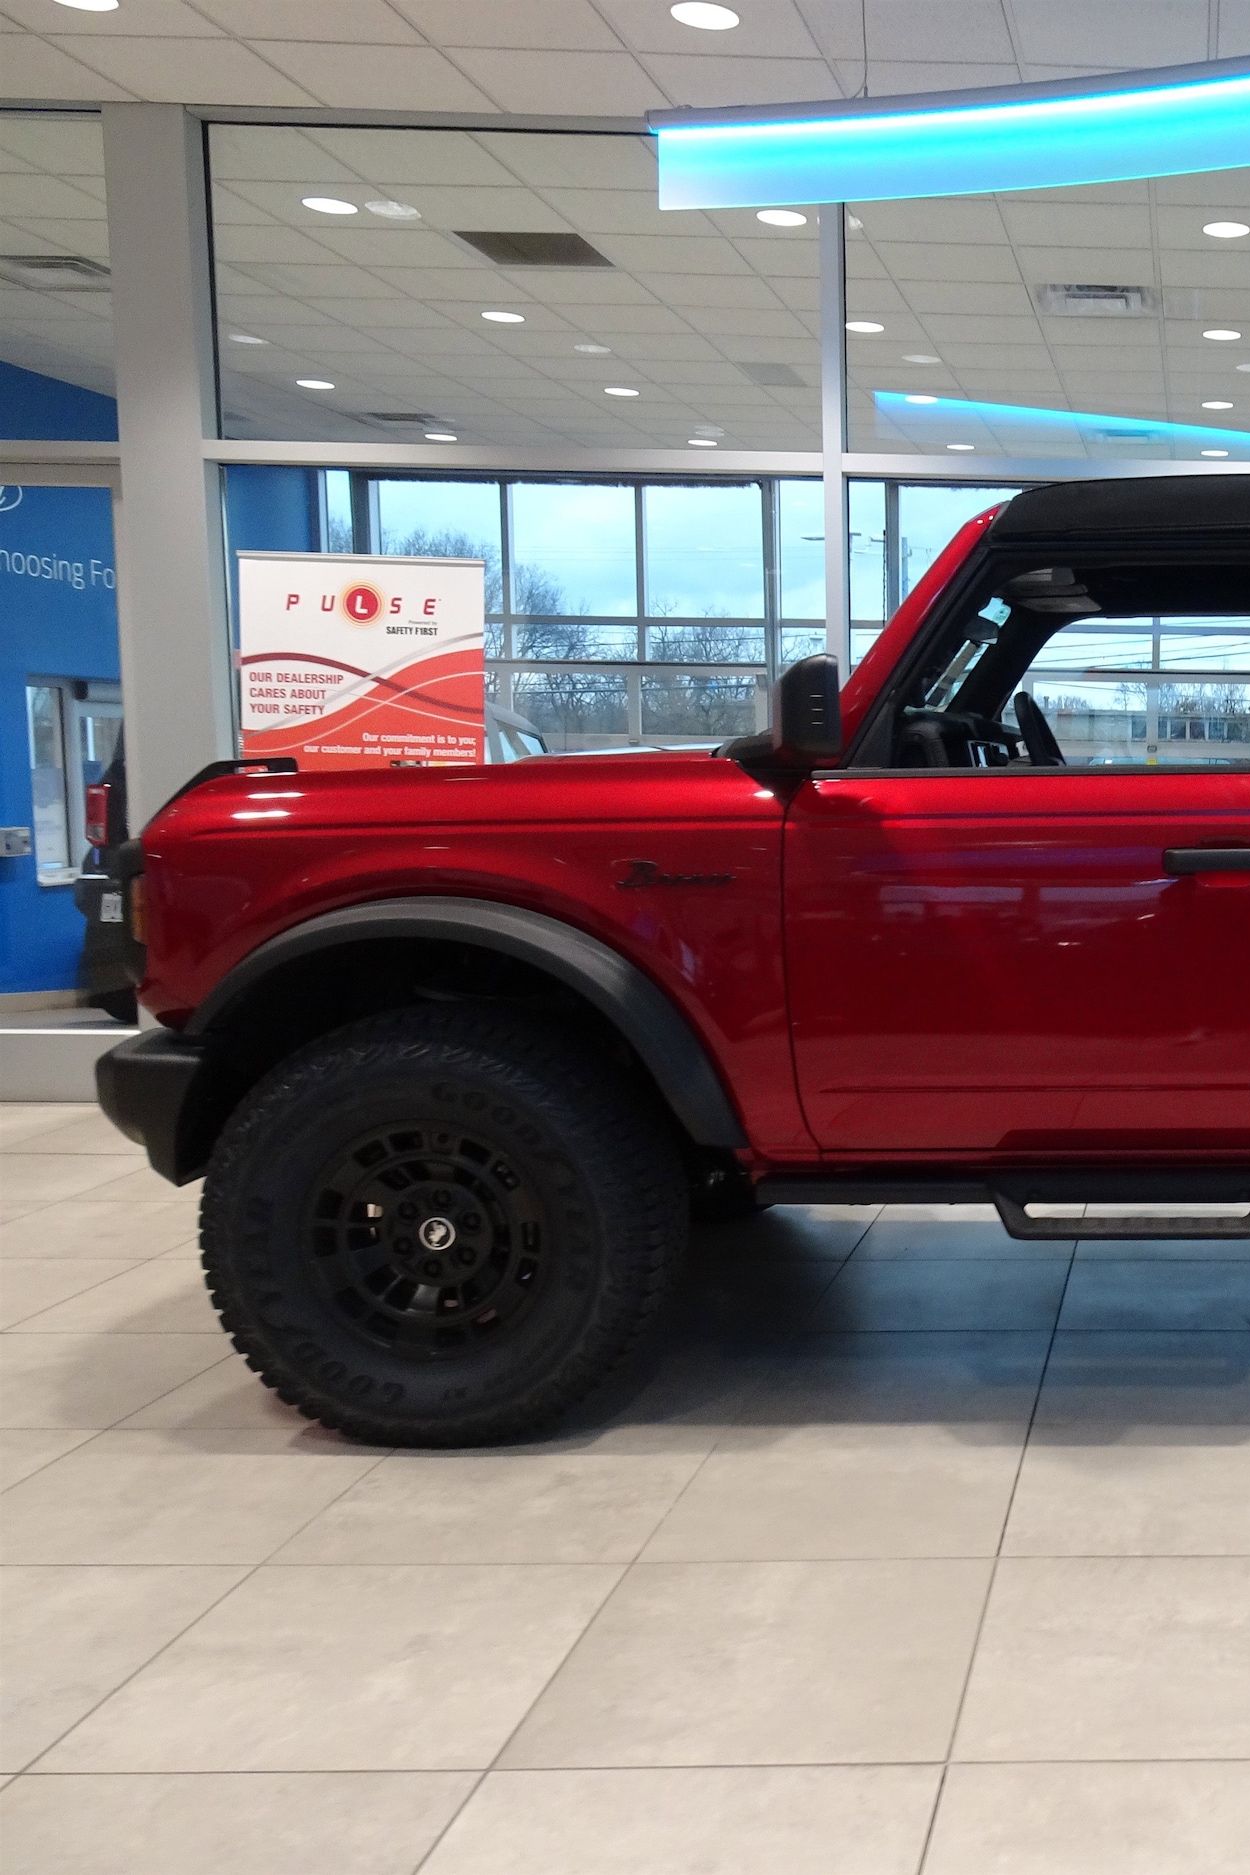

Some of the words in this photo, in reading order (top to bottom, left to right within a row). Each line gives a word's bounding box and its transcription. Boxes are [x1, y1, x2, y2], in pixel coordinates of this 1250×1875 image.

[286, 593, 436, 616] PULSE
[386, 626, 413, 635] SAFETY
[249, 672, 272, 683] OUR
[276, 672, 344, 684] DEALERSHIP
[249, 687, 286, 699] CARES
[290, 689, 326, 700] ABOUT
[249, 703, 280, 714] YOUR
[284, 704, 325, 715] SAFETY
[363, 733, 379, 742] Our
[381, 734, 435, 744] commitment
[437, 735, 446, 744] is
[447, 734, 457, 744] to
[303, 745, 319, 753] our
[320, 745, 362, 754] customer
[364, 746, 381, 755] and
[383, 747, 403, 757] your
[404, 746, 431, 758] family
[433, 747, 477, 758] members!
